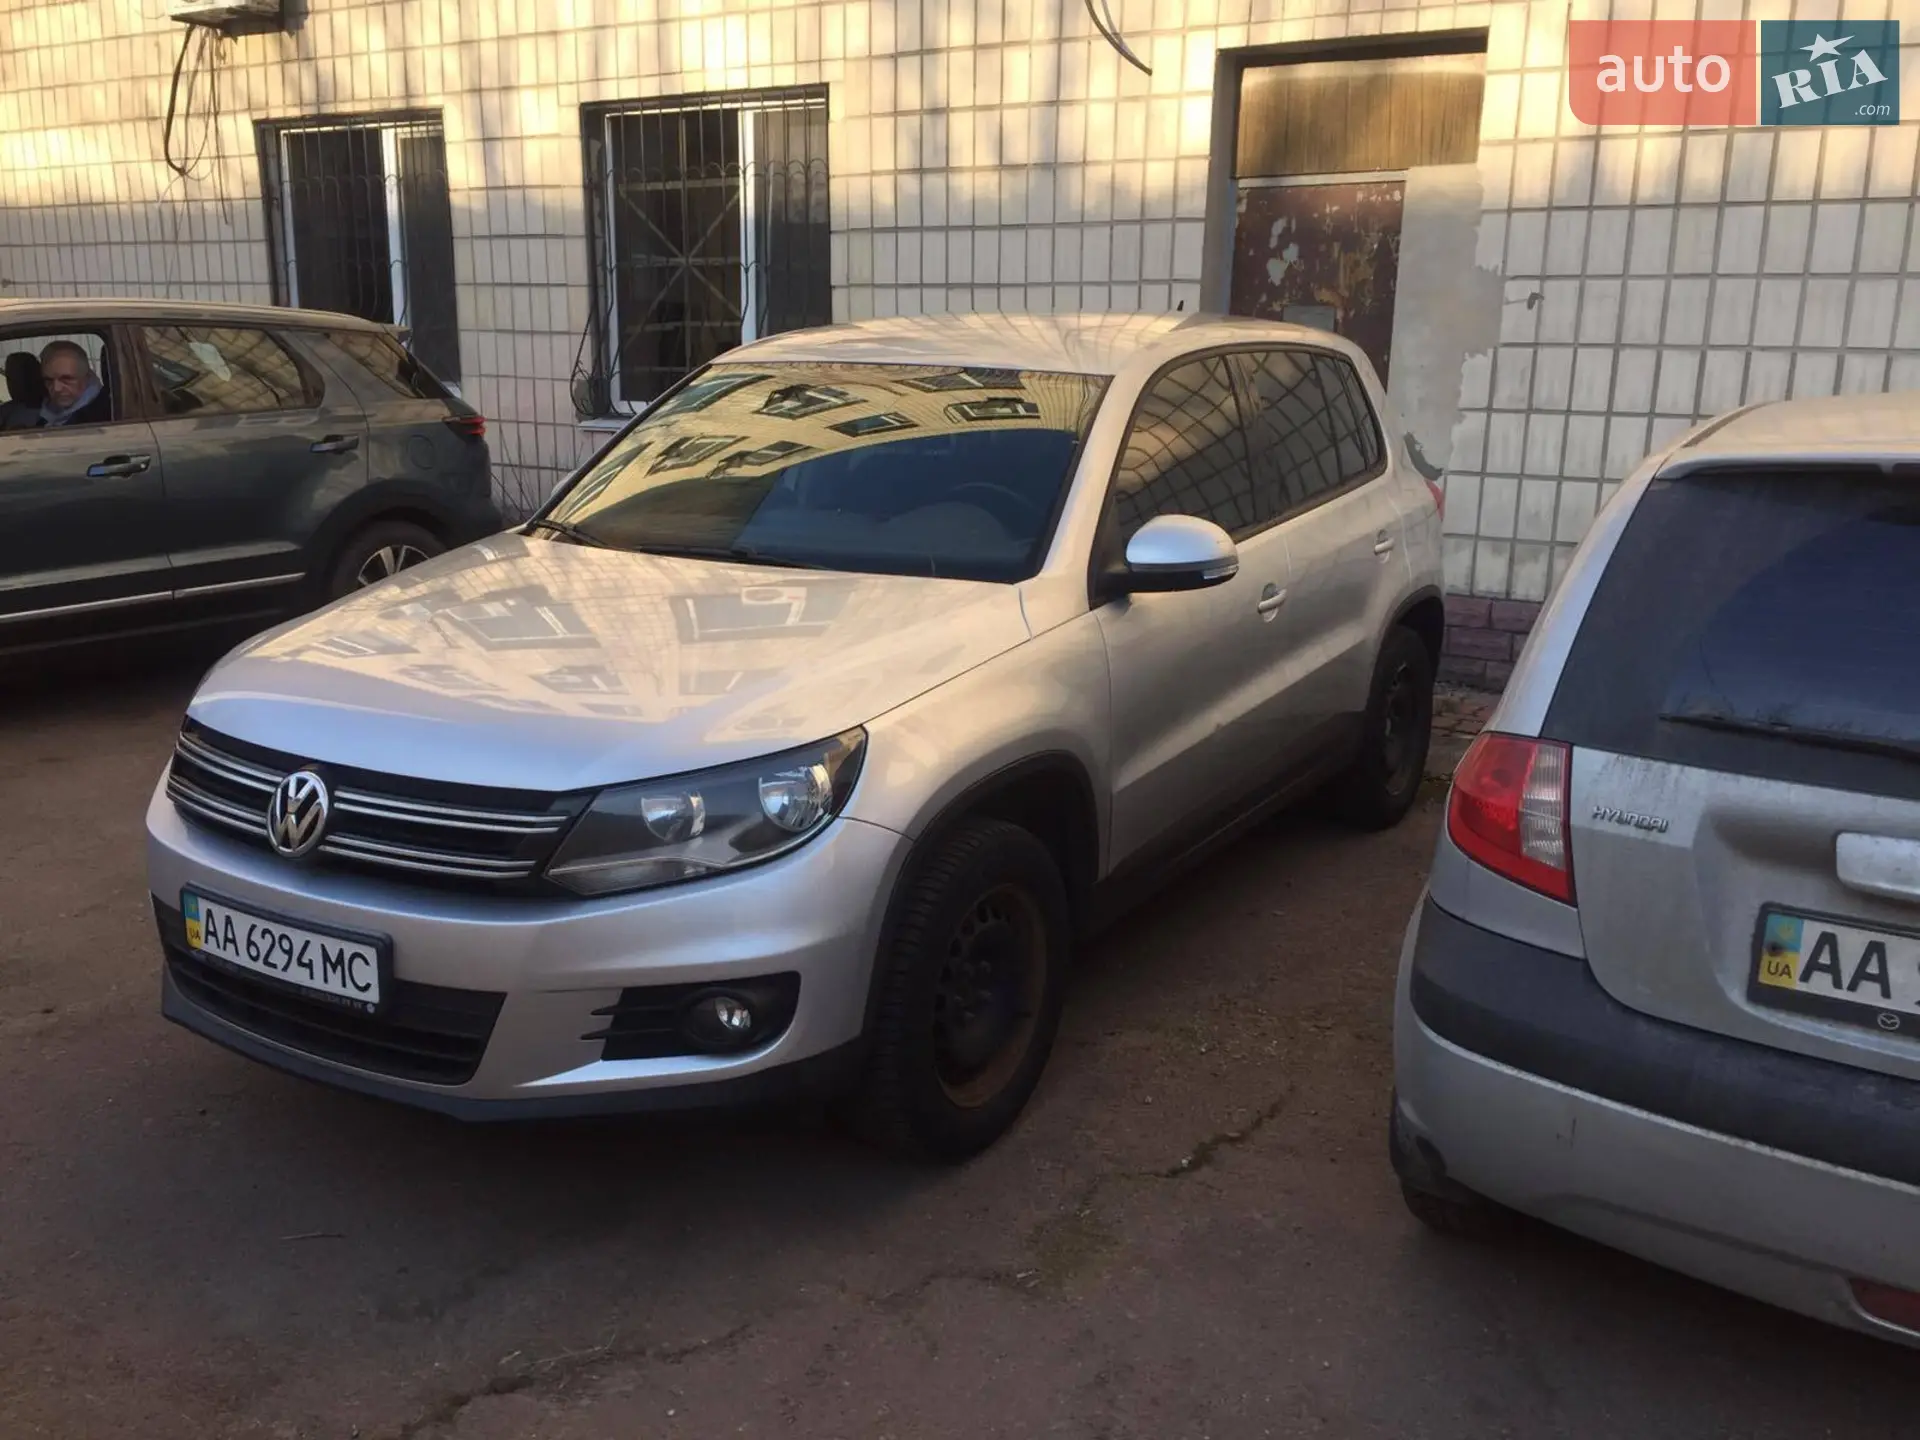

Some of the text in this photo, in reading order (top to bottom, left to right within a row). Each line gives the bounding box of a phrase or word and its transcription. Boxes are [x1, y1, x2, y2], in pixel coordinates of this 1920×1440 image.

[1592, 806, 1669, 833] HYUNDAI
[204, 908, 372, 992] AA 6294 MC
[1767, 960, 1793, 980] UA
[1798, 930, 1892, 1000] AA
